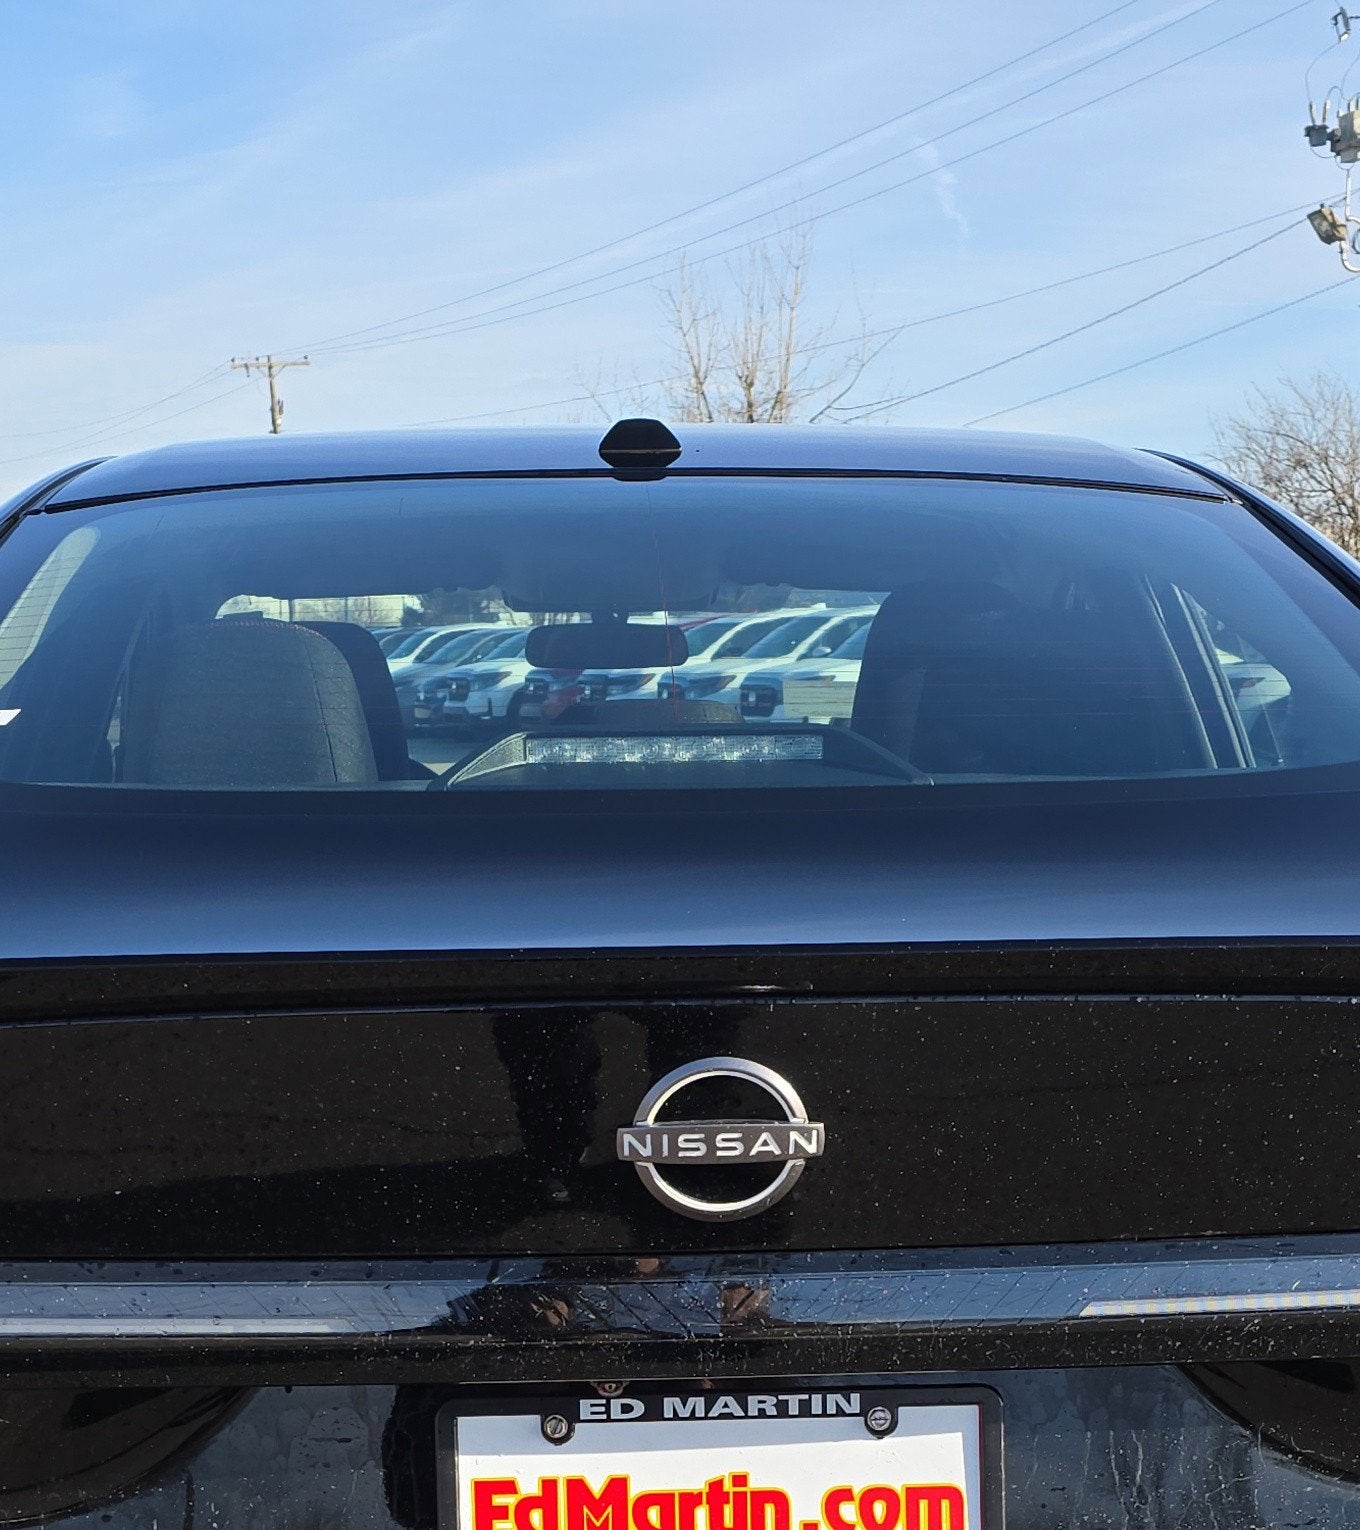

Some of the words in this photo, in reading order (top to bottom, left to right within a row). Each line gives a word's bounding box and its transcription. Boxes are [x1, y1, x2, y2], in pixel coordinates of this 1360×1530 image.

[622, 1129, 819, 1158] NISSAN
[578, 1398, 646, 1421] ED
[662, 1393, 862, 1419] MARTIN
